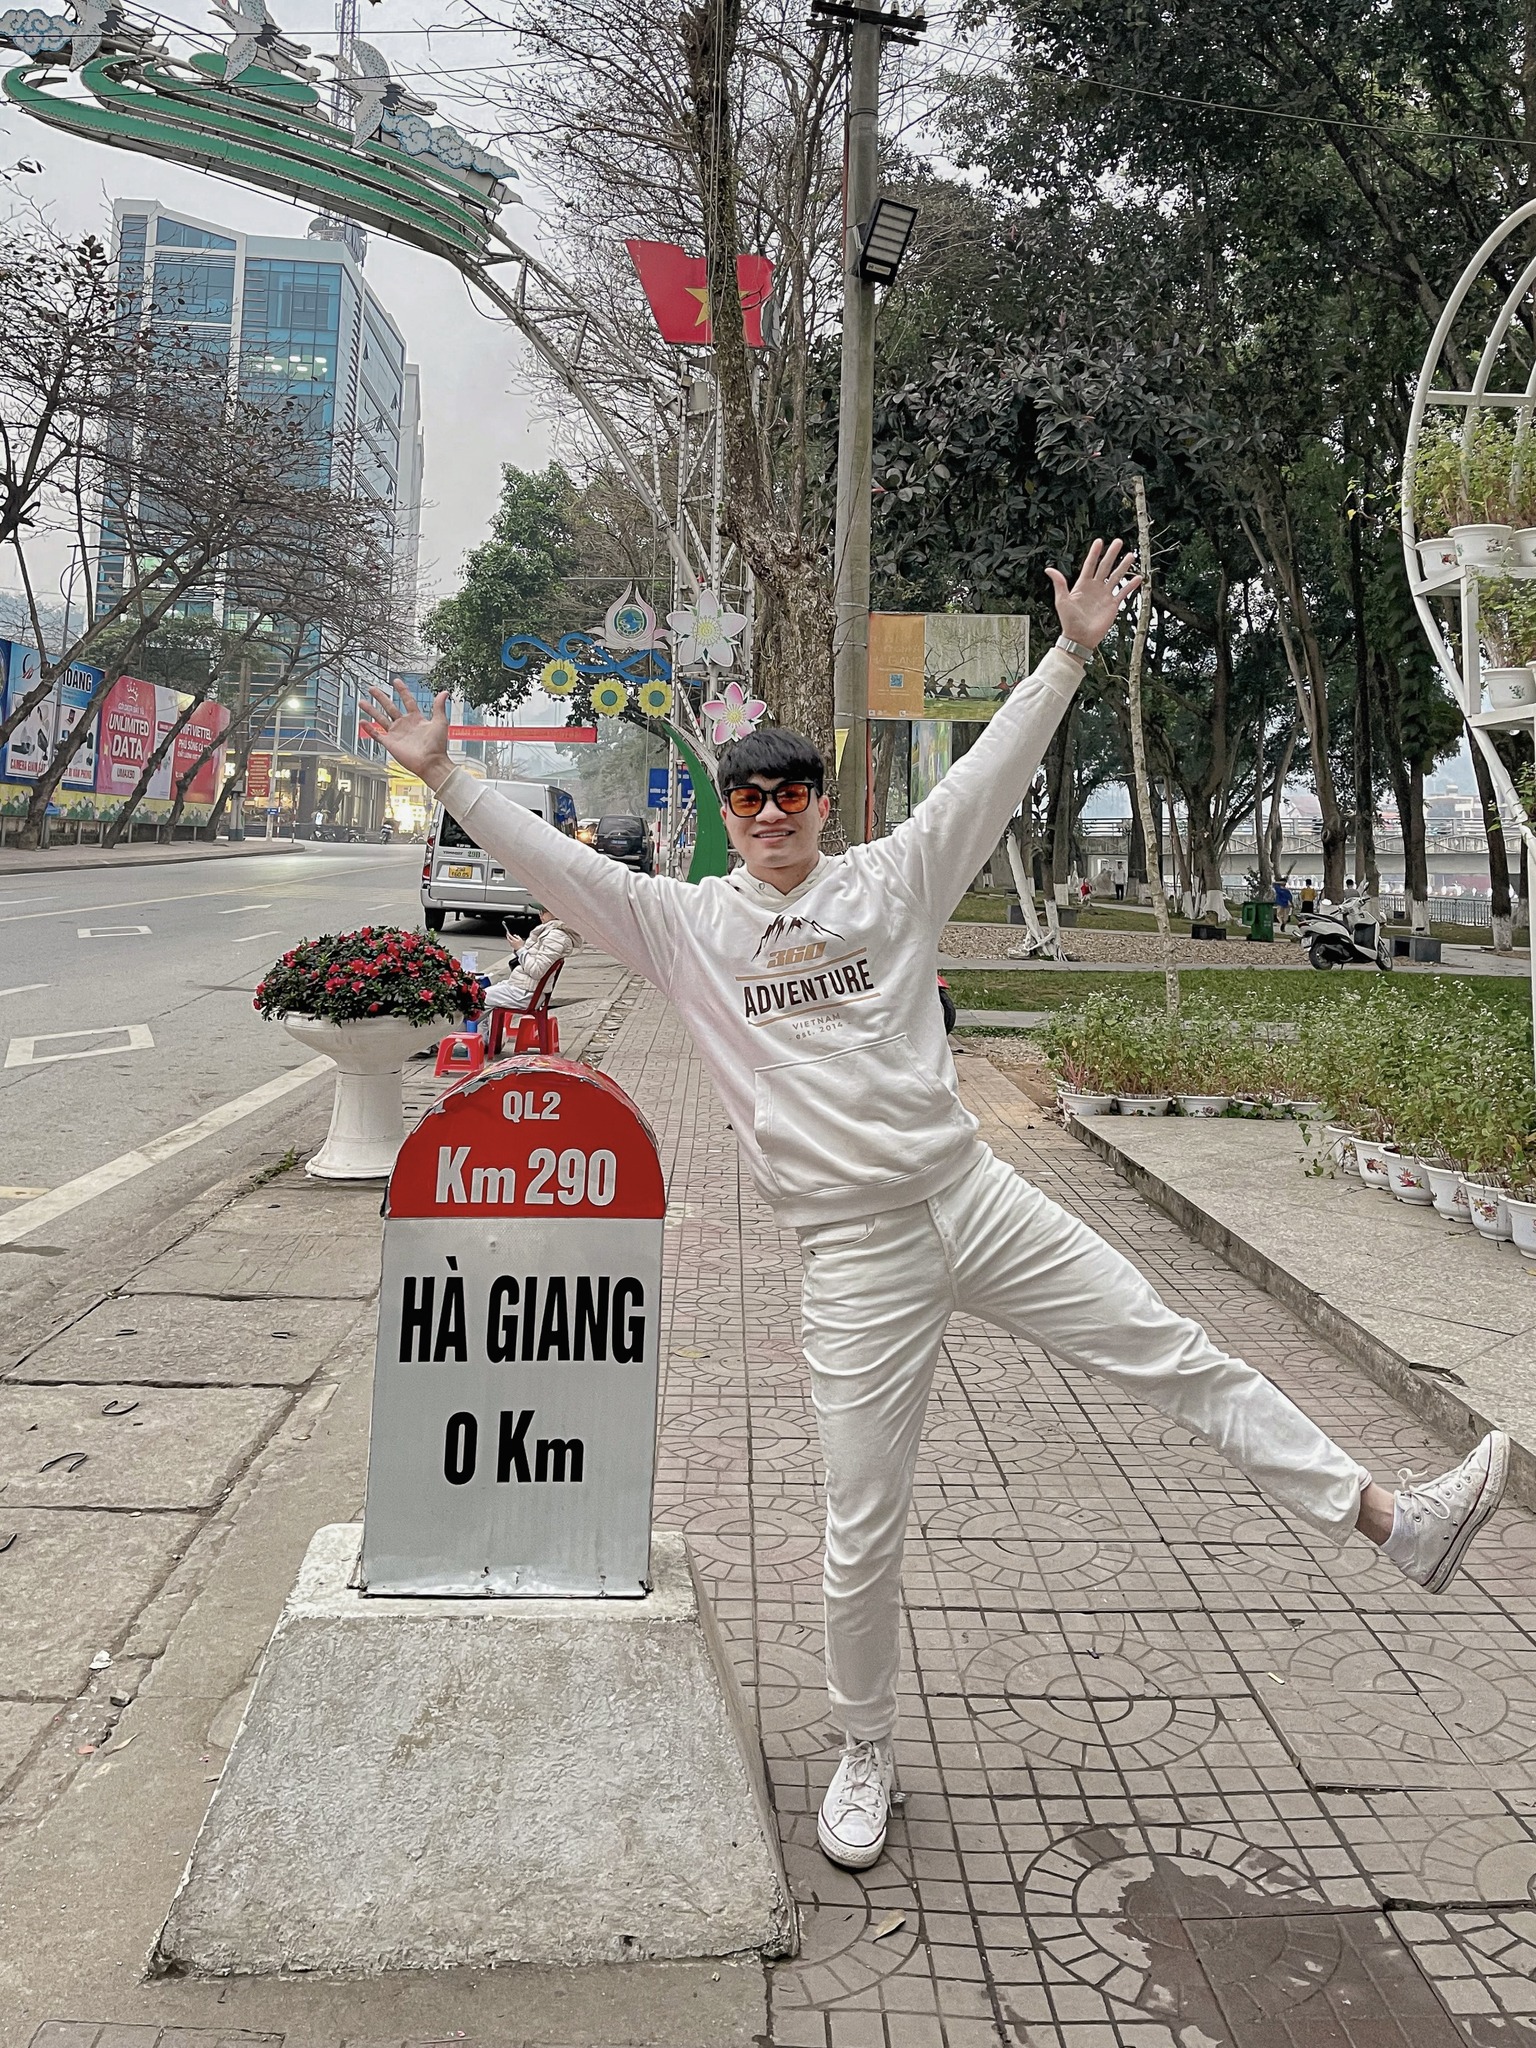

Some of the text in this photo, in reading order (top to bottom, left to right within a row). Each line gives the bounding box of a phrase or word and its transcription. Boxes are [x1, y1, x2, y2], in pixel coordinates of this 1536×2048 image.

[108, 713, 149, 737] UNLIMITED
[192, 725, 212, 740] VIETTEL
[112, 735, 143, 760] DATA
[767, 941, 827, 968] 360
[743, 958, 875, 1018] ADVENTURE
[792, 1012, 841, 1030] VIETNAM
[819, 1021, 844, 1033] 2014
[502, 1091, 561, 1122] QL2
[435, 1146, 617, 1207] Km 290
[399, 1256, 646, 1364] HÀ GIANG
[443, 1410, 584, 1486] 0 Km
